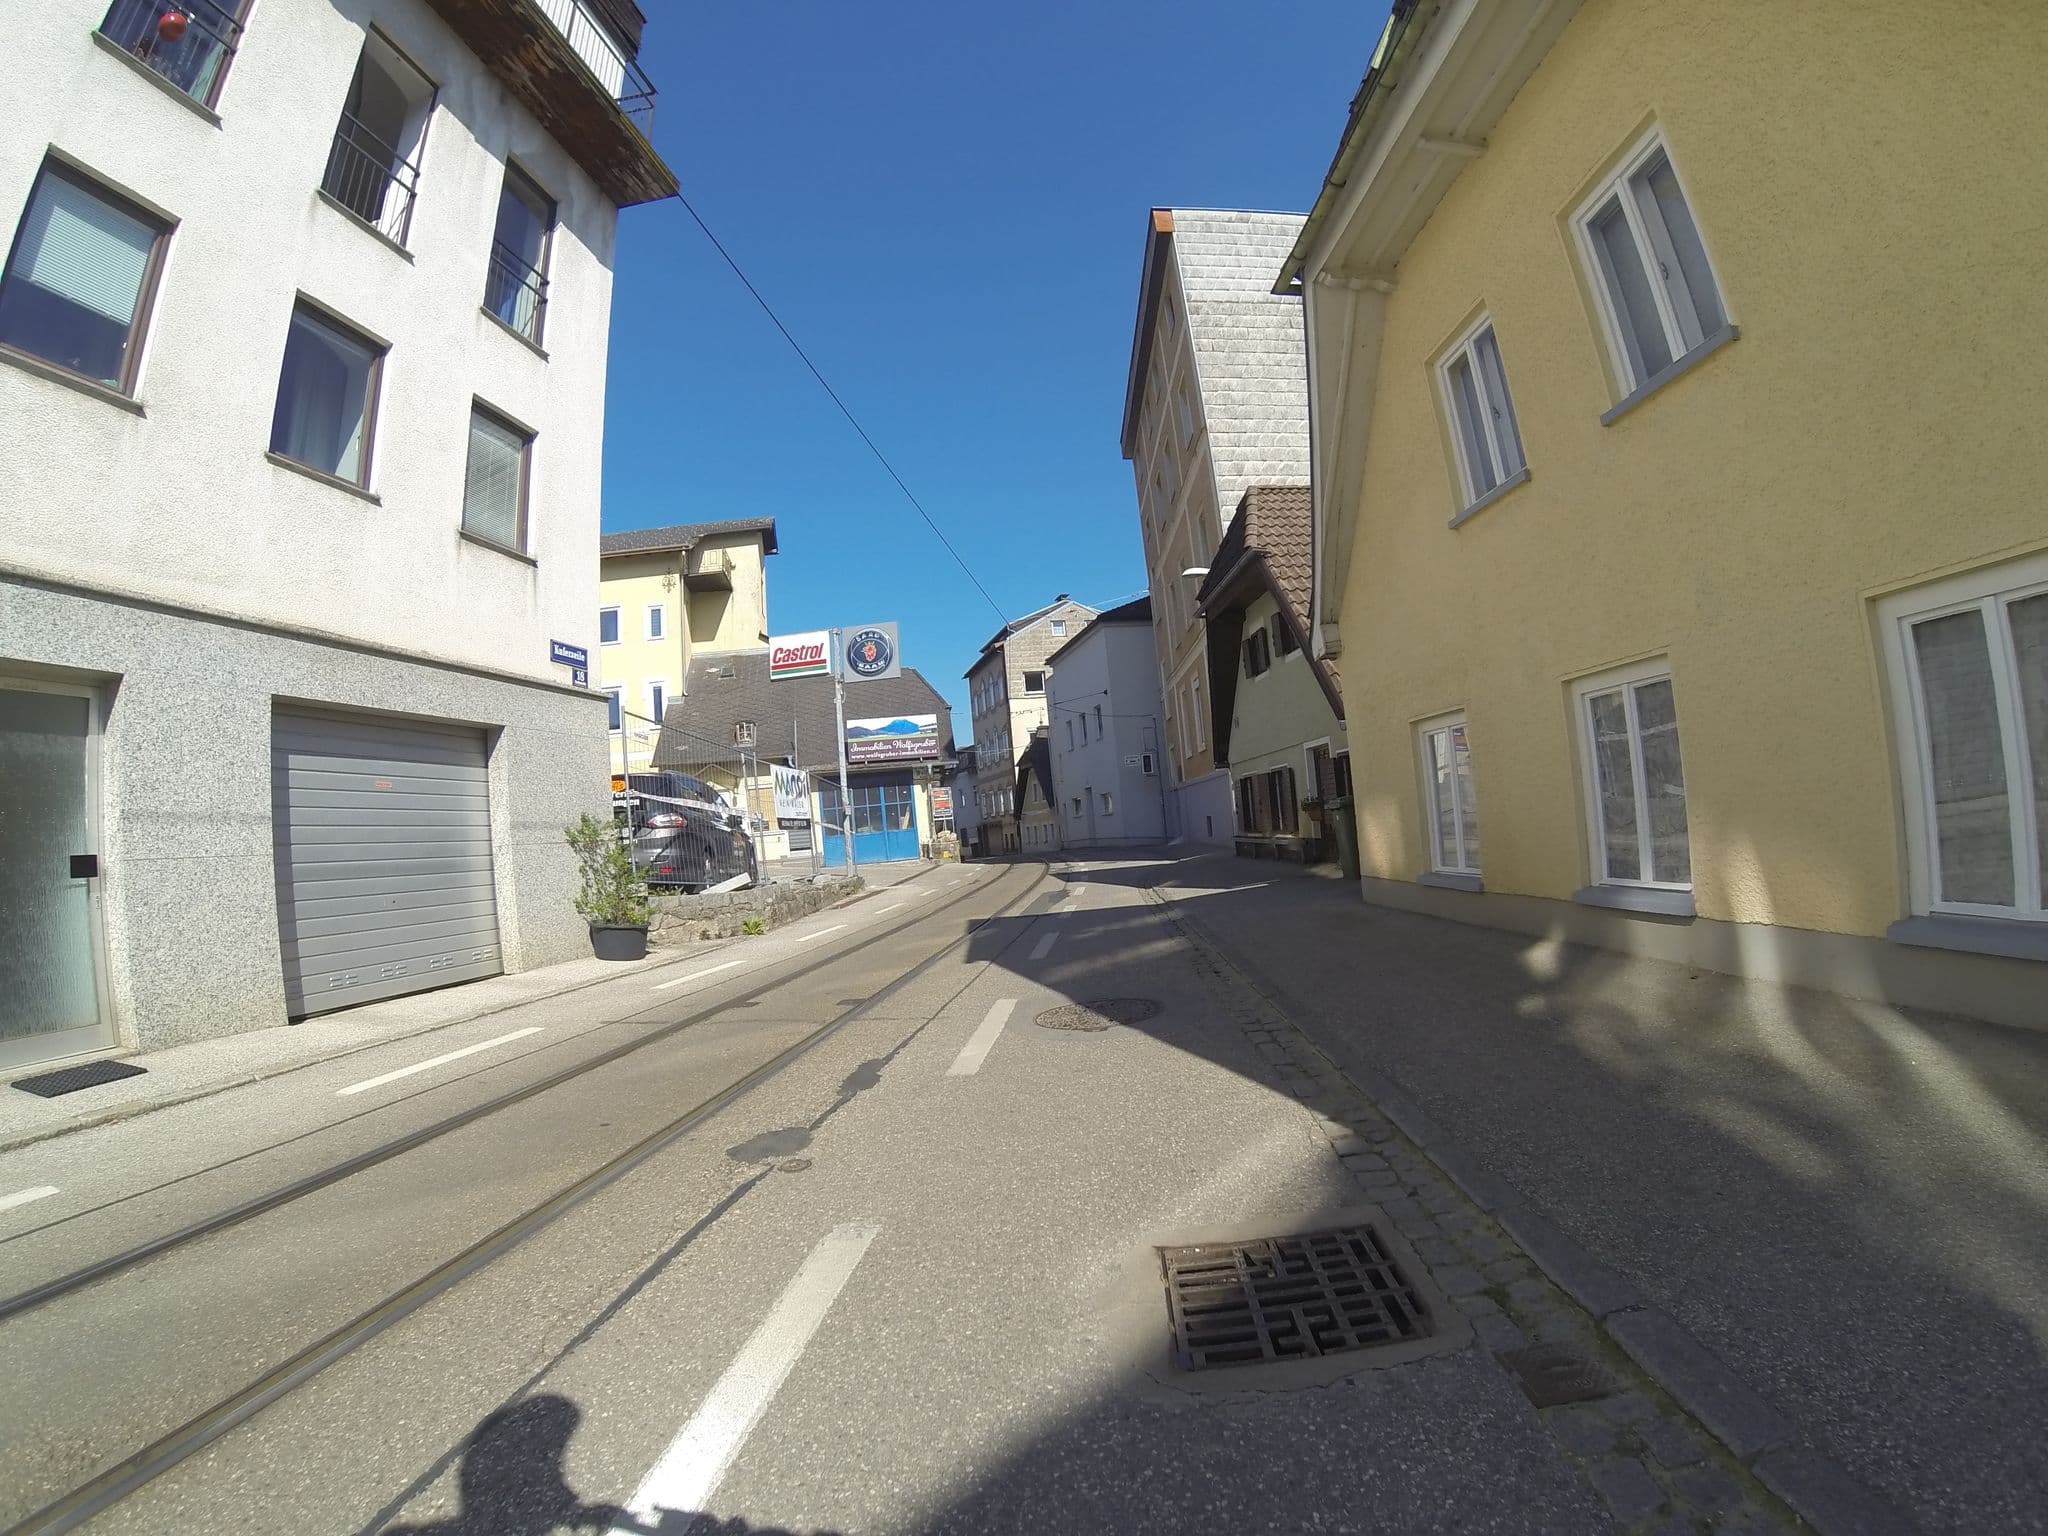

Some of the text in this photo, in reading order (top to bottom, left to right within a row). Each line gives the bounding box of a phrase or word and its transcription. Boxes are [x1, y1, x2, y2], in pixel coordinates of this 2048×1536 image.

[772, 643, 824, 664] Castrol
[576, 670, 585, 681] 18
[850, 738, 936, 753] Immobilien Wolfsgruber
